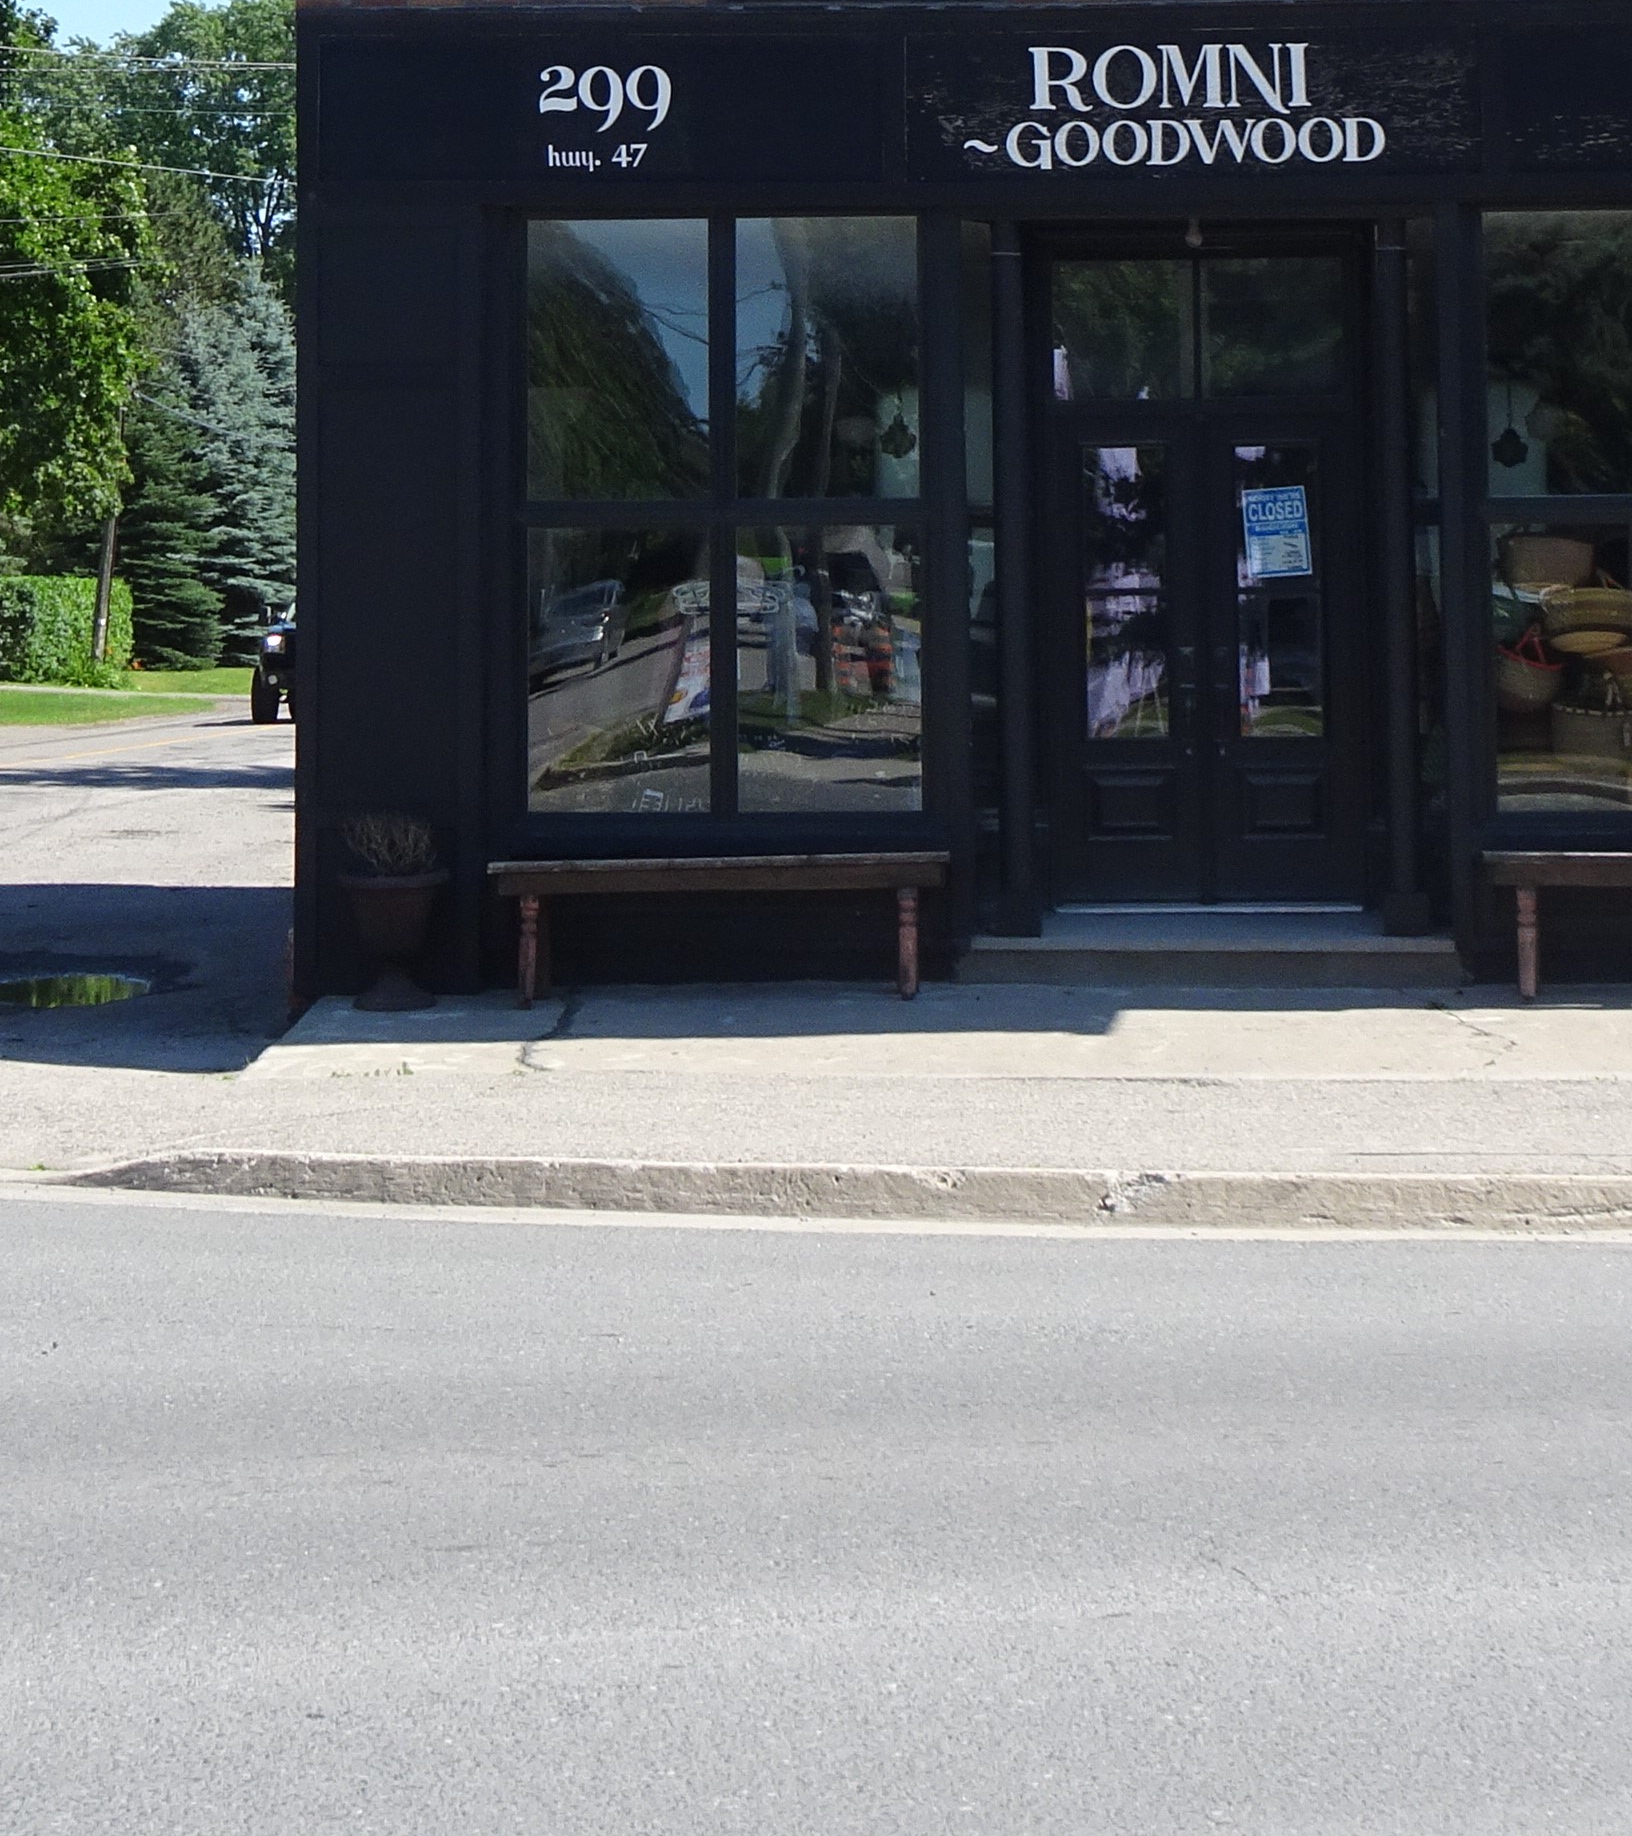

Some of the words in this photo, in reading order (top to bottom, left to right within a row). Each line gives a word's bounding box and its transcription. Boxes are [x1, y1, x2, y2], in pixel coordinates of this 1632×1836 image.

[539, 65, 672, 133] 299
[1028, 42, 1313, 115] ROMNI
[547, 144, 602, 172] hwy.
[611, 143, 648, 168] 47
[1248, 500, 1304, 522] CLOSED
